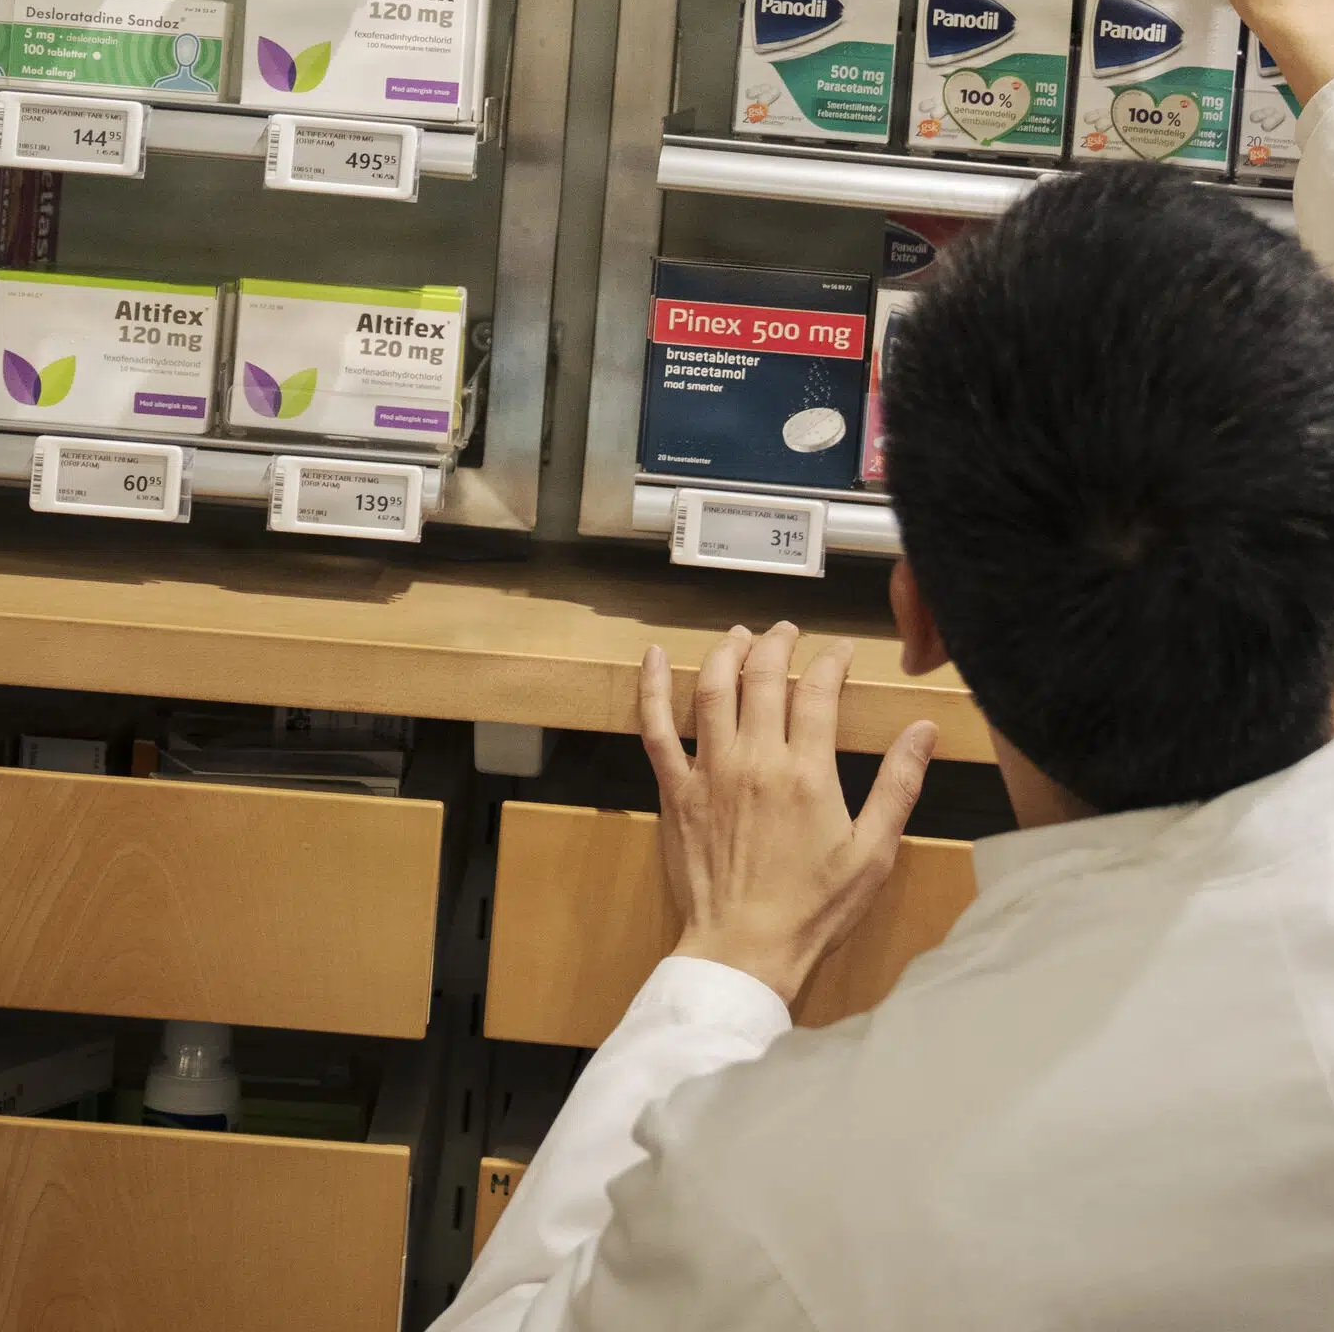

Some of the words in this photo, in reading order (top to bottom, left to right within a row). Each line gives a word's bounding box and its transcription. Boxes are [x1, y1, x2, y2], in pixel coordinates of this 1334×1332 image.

[369, 1, 411, 20] 120
[417, 7, 454, 27] mg
[959, 91, 994, 106] 100
[954, 106, 1018, 122] genanvendelig
[669, 308, 741, 336] Pinex
[753, 321, 800, 343] 500
[809, 325, 851, 349] mg
[667, 349, 760, 366] brusetabletter
[665, 365, 745, 380] paracetamol
[664, 380, 684, 389] mod
[687, 382, 723, 393] smerter
[491, 1174, 510, 1195] M
